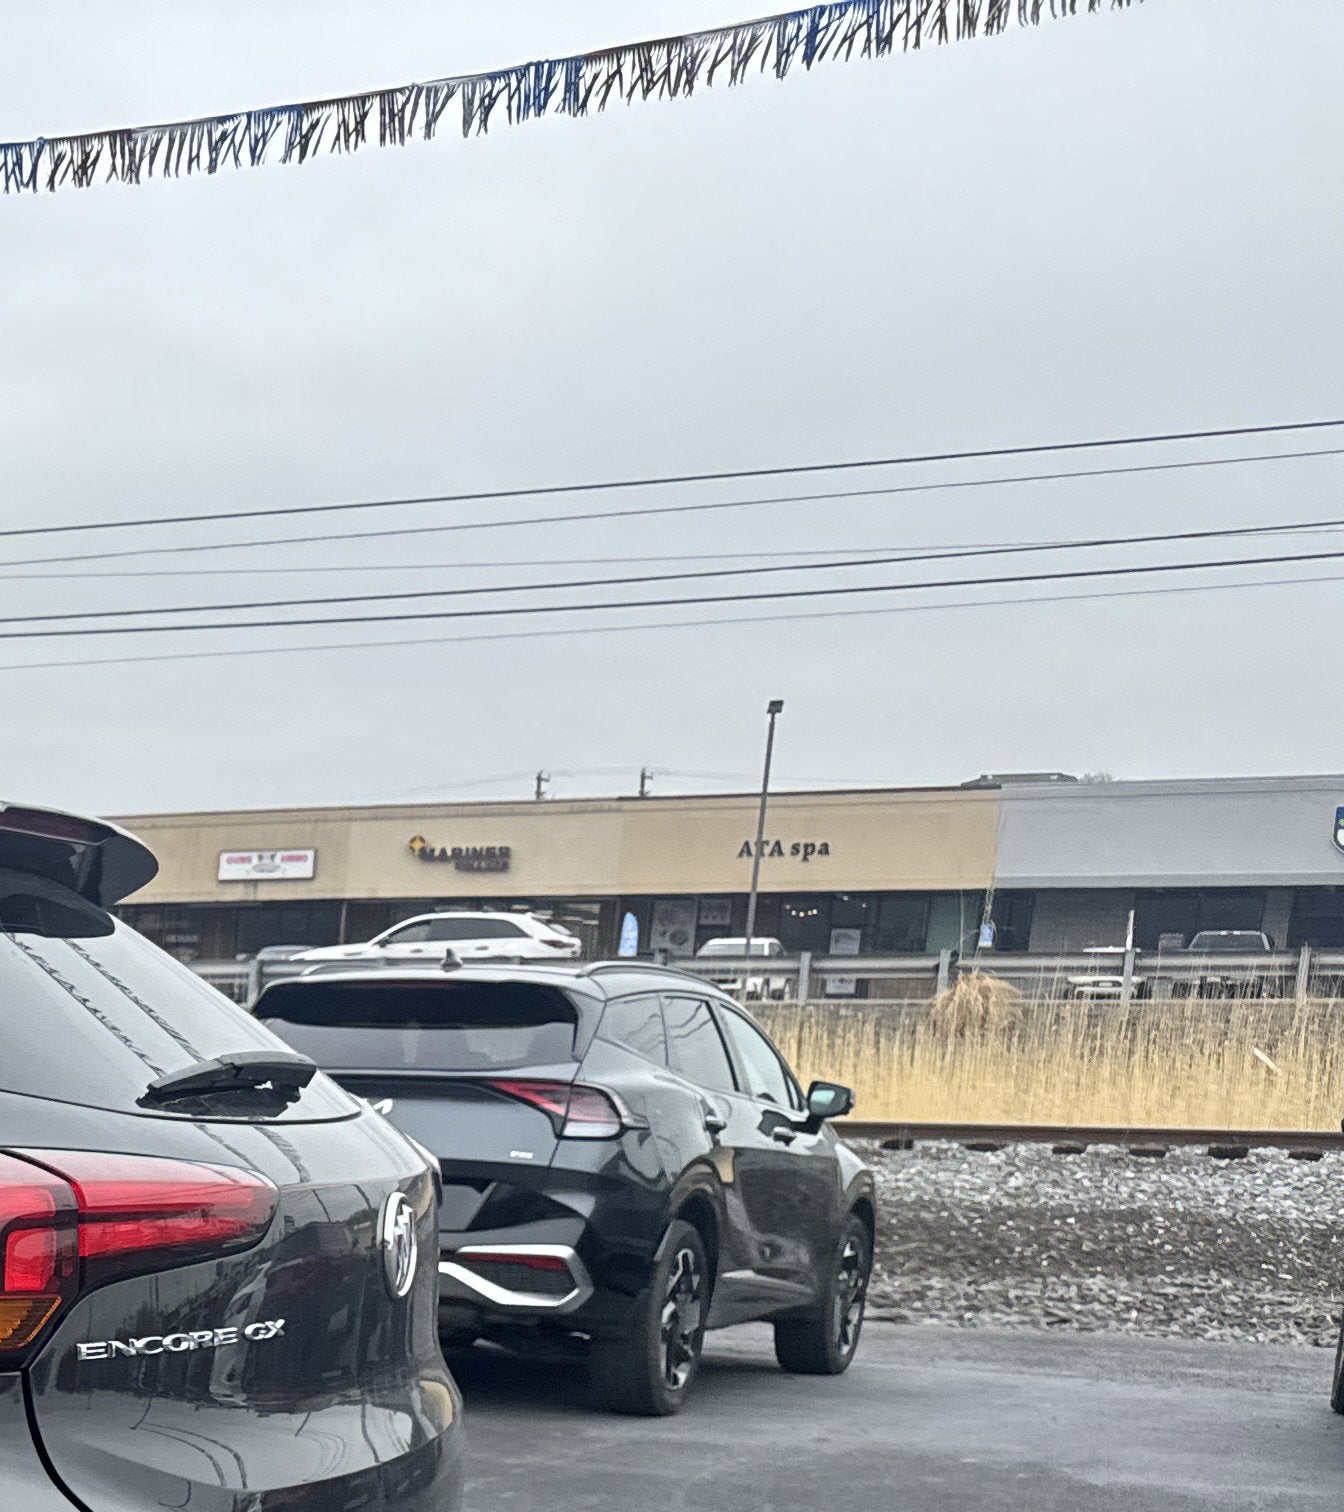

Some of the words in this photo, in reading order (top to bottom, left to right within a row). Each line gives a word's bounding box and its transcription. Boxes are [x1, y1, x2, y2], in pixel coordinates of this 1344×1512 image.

[419, 846, 510, 863] MARINER
[737, 839, 784, 858] ATA
[790, 841, 830, 862] spa
[76, 1326, 240, 1361] ENCORE
[243, 1318, 286, 1341] GX
